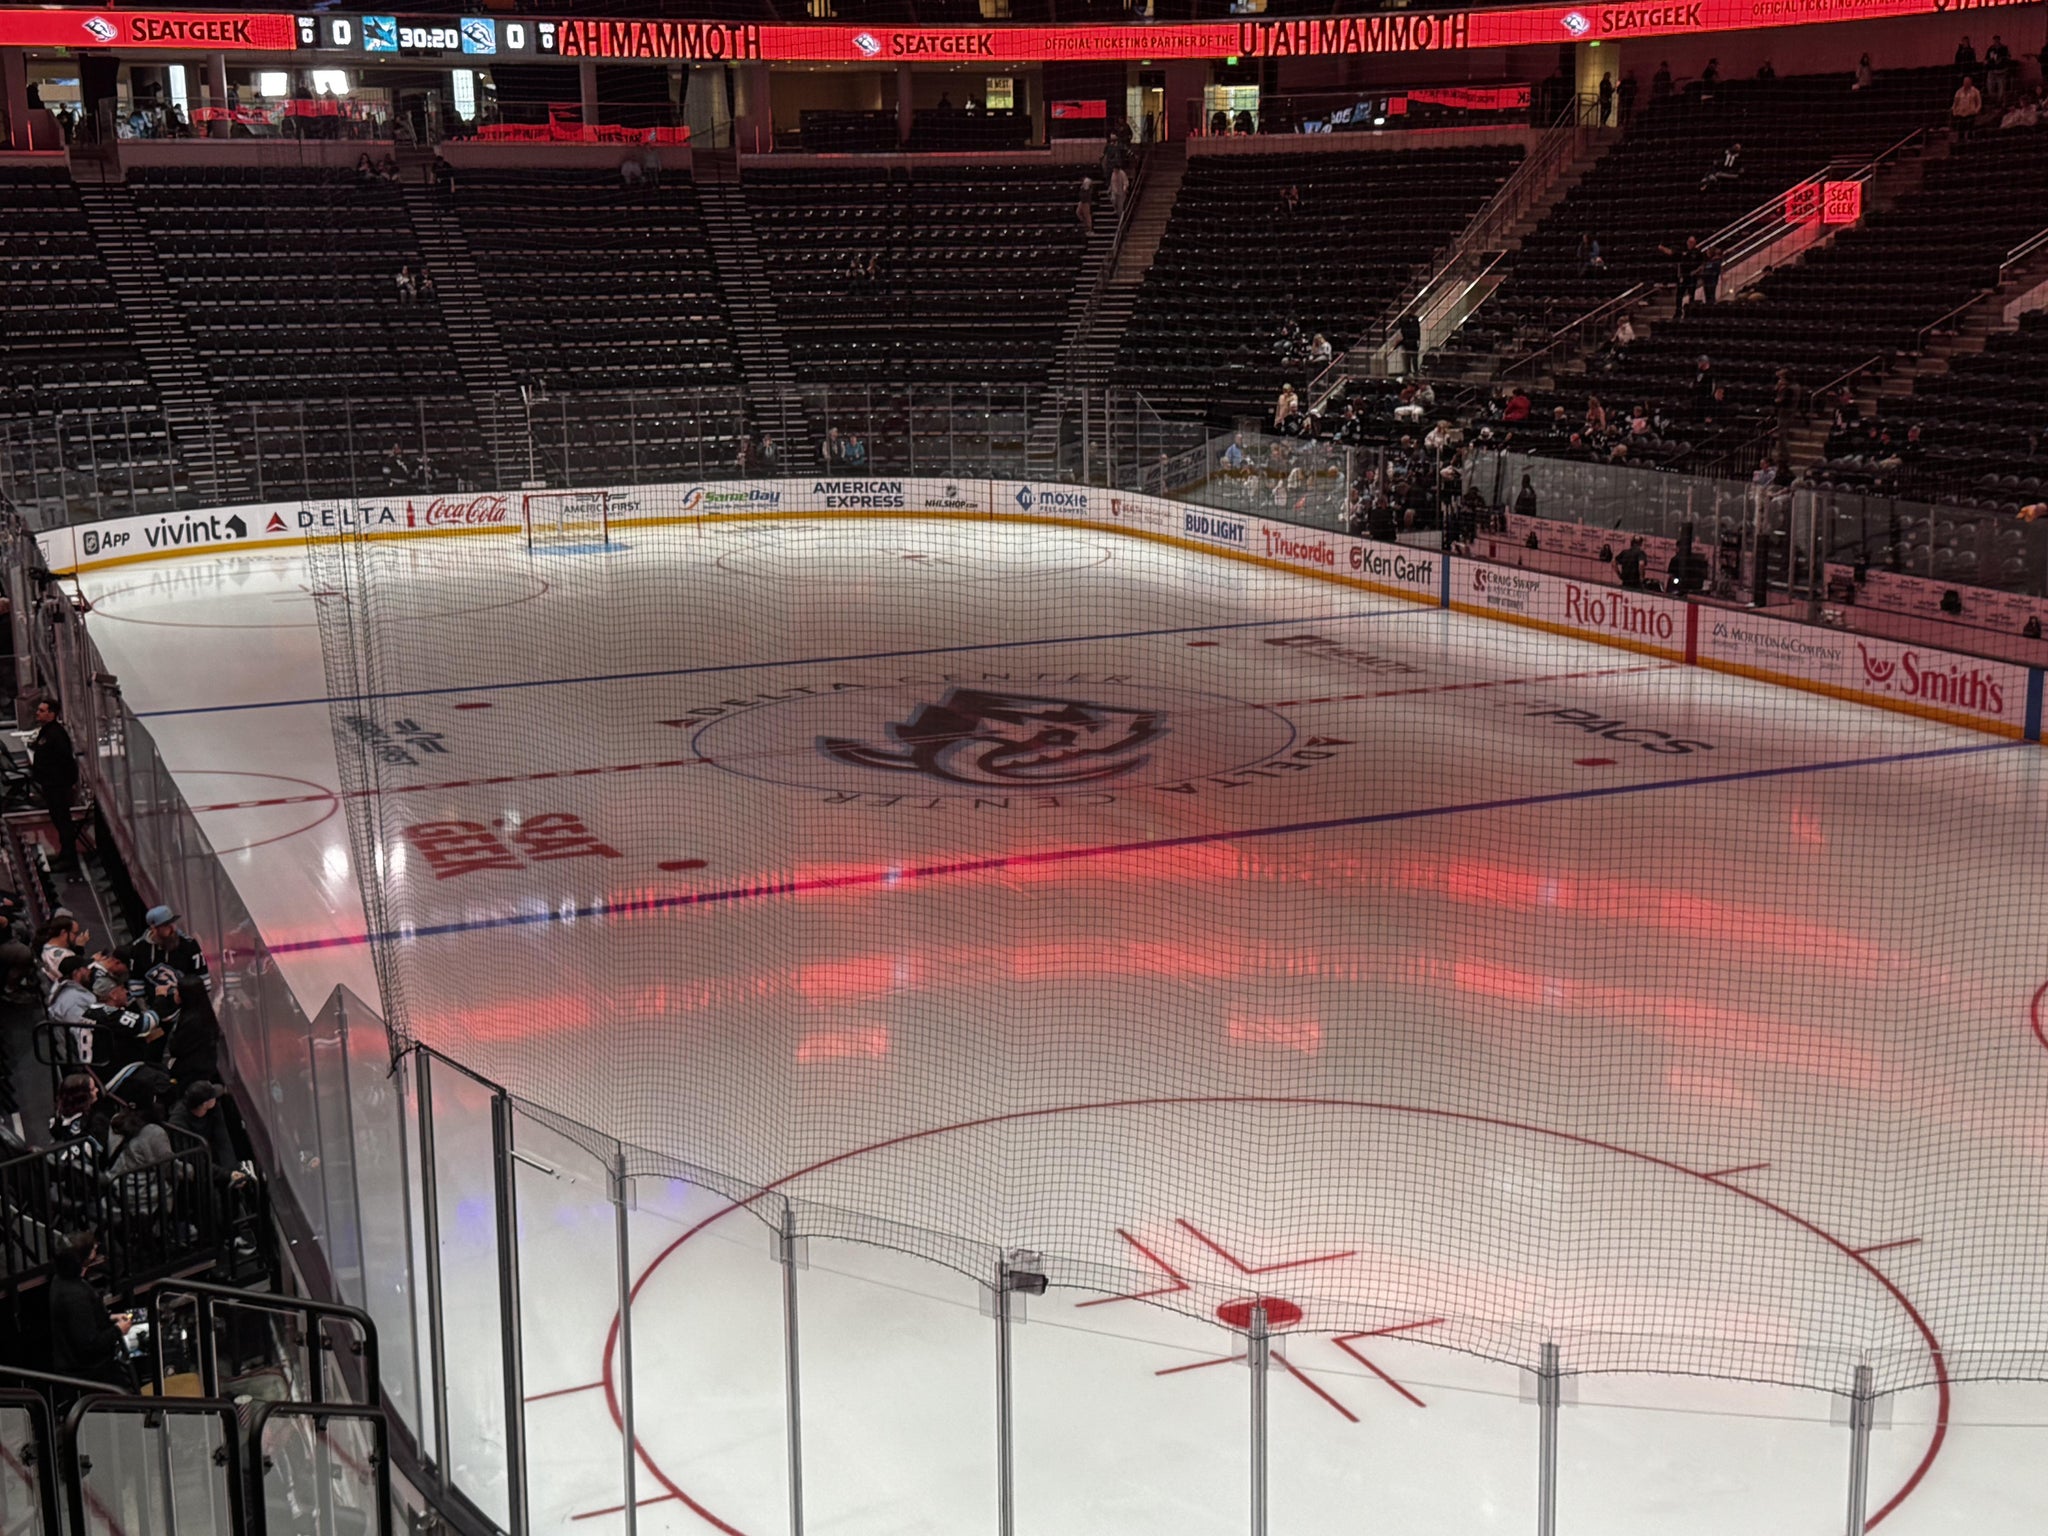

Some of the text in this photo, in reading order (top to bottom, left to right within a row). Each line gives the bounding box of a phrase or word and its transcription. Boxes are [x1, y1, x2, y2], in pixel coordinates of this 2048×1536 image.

[1602, 2, 1701, 33] SEATGEEK
[1753, 2, 1797, 16] OFFICIAL
[131, 17, 252, 43] SEATGEEK
[332, 20, 351, 45] 0
[400, 28, 458, 48] 30:20
[506, 24, 524, 49] 0
[608, 22, 760, 59] MAMMOTH
[1045, 34, 1235, 50] OFFICIAL TICKETING PARTNER OF THE
[1239, 14, 1468, 56] UTAH MAMMOTH
[892, 33, 993, 55] SEATGEEK
[1830, 188, 1855, 201] SEAT
[1829, 202, 1855, 216] GEEK
[813, 482, 902, 494] AMERICAN
[1040, 491, 1088, 508] moxie
[611, 501, 641, 512] FIRST
[826, 495, 904, 508] EXPRESS
[298, 507, 396, 529] DELTA
[1185, 514, 1210, 535] BUD
[1210, 518, 1245, 543] LIGHT
[144, 515, 222, 547] vivint
[1272, 531, 1335, 566] Trucordia
[1363, 547, 1433, 587] Ken Garff
[1900, 651, 2004, 714] Smith's
[492, 813, 624, 862] SEAT
[401, 820, 527, 881] GEEK
